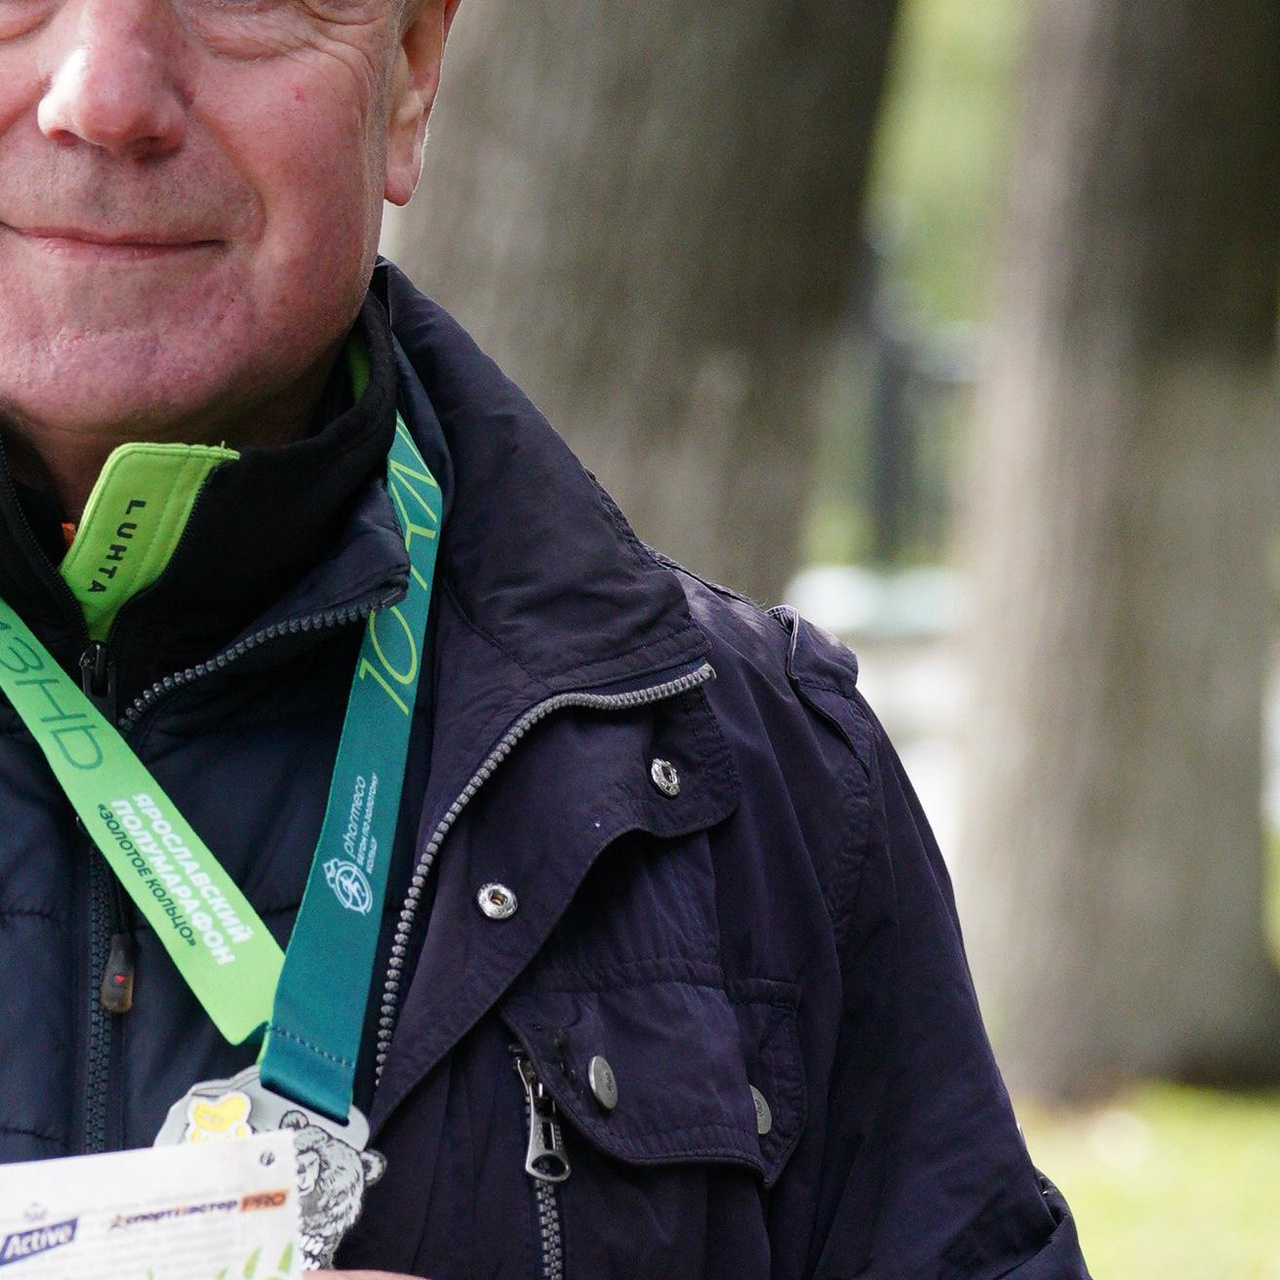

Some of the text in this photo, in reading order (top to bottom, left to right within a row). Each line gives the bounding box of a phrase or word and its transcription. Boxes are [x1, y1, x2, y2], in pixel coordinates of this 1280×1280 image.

[87, 499, 147, 593] LUHTA
[359, 605, 418, 716] 10
[132, 792, 254, 944] ЯРОСЛАВСКИЙ
[343, 776, 366, 860] pharmeco
[98, 804, 197, 947] «ЗОЛОТОЕ КОЛЬЦО»
[111, 799, 236, 966] ПОЛУМАРАФОН
[3, 1223, 72, 1259] Active
